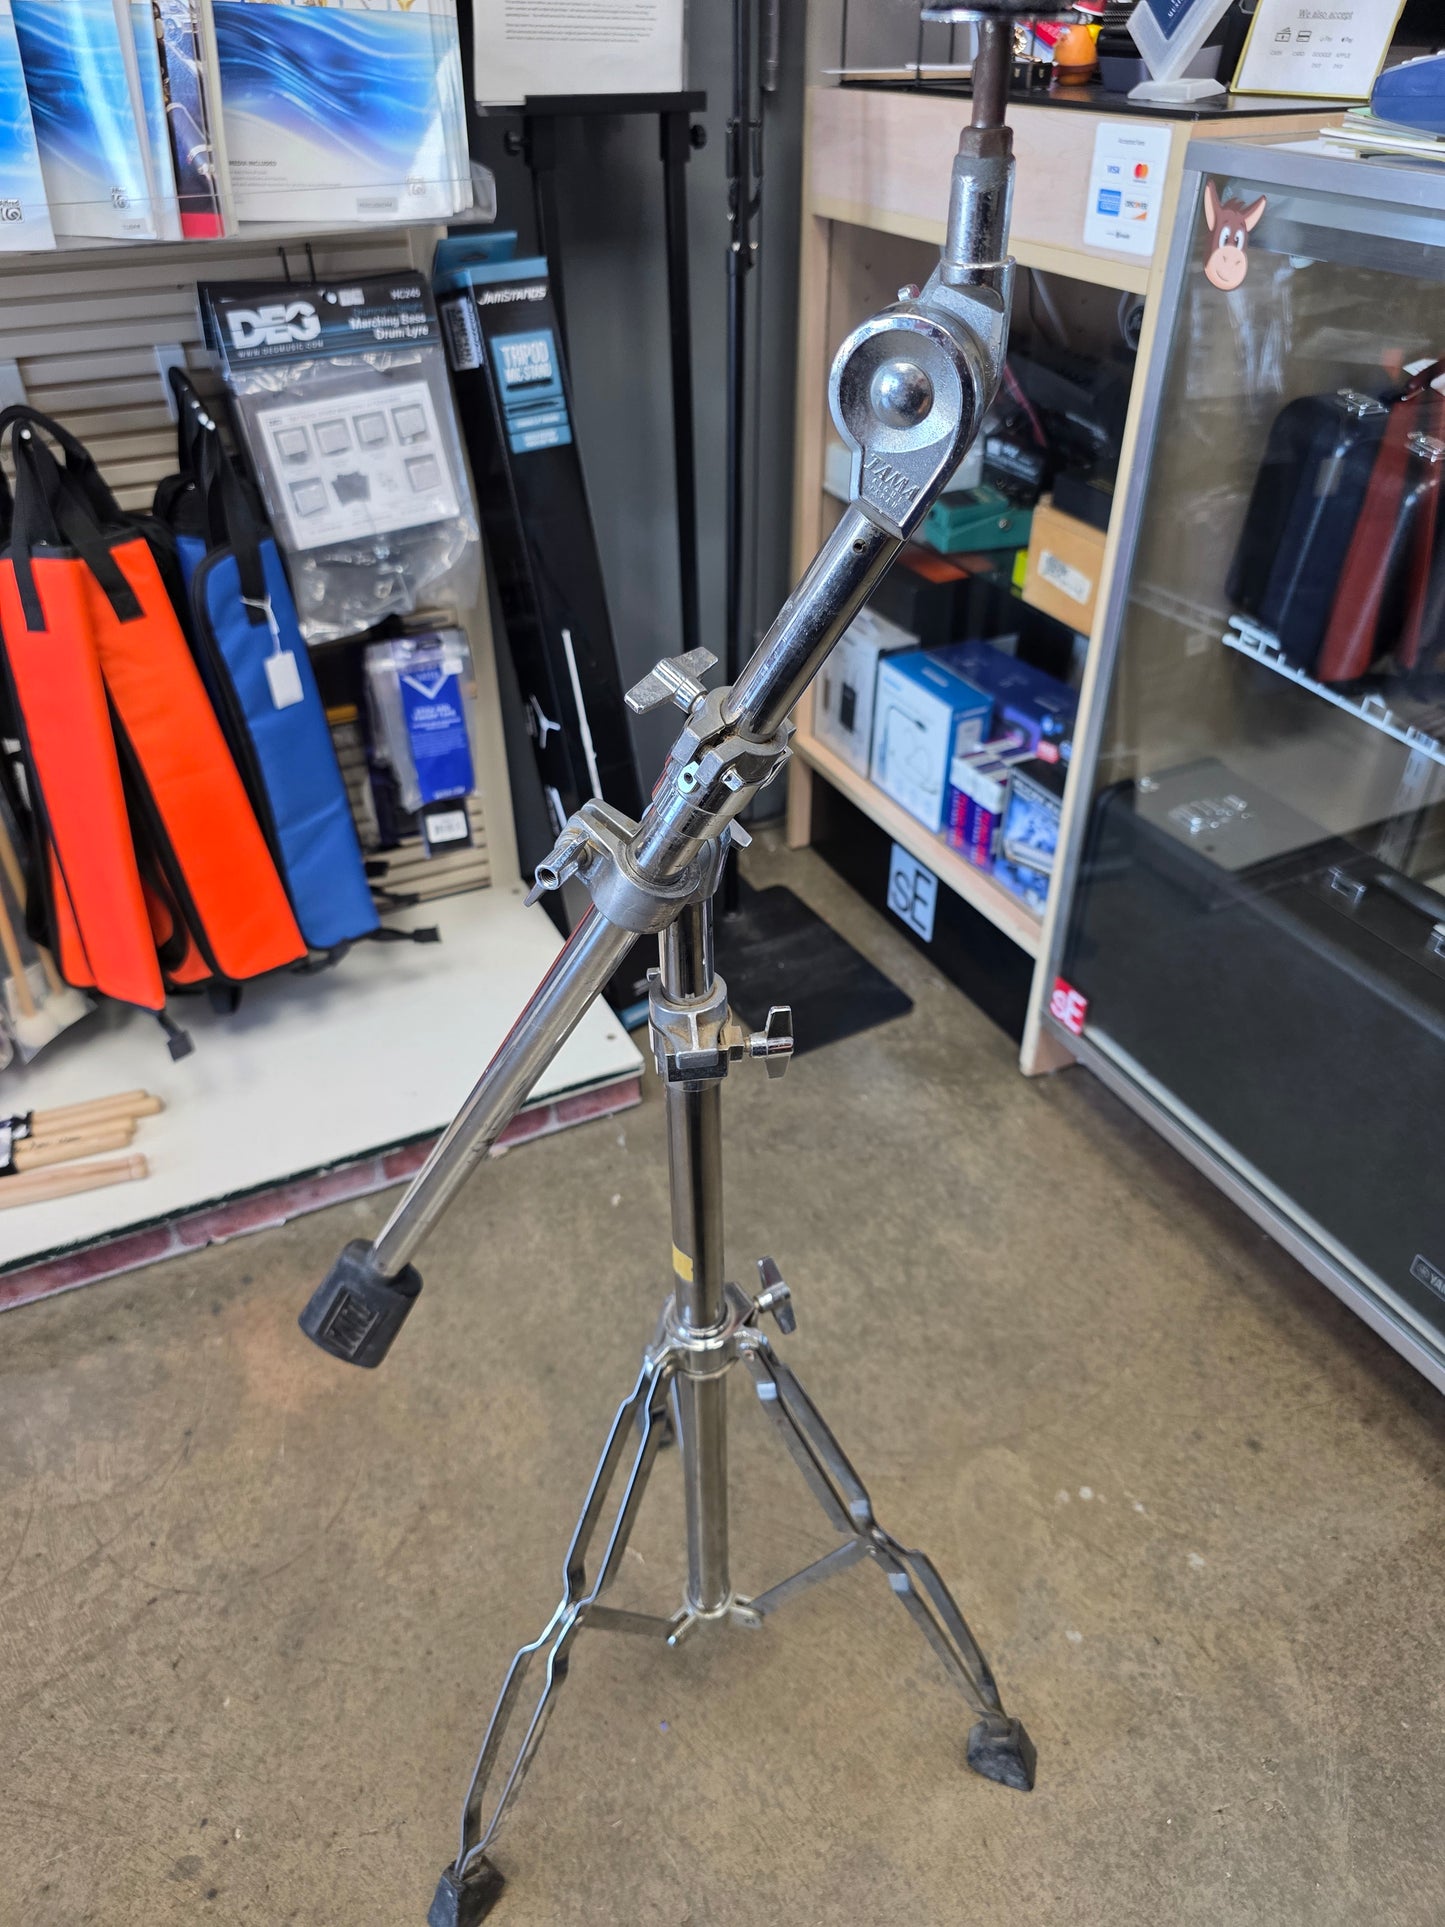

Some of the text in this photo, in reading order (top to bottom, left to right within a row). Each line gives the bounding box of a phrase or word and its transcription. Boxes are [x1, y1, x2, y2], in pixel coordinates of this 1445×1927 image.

[226, 301, 321, 350] DEG
[348, 313, 427, 330] Marching Bass
[374, 325, 429, 340] Drum Lyre
[501, 340, 551, 367] TRIPOD
[864, 453, 920, 502] TAMA
